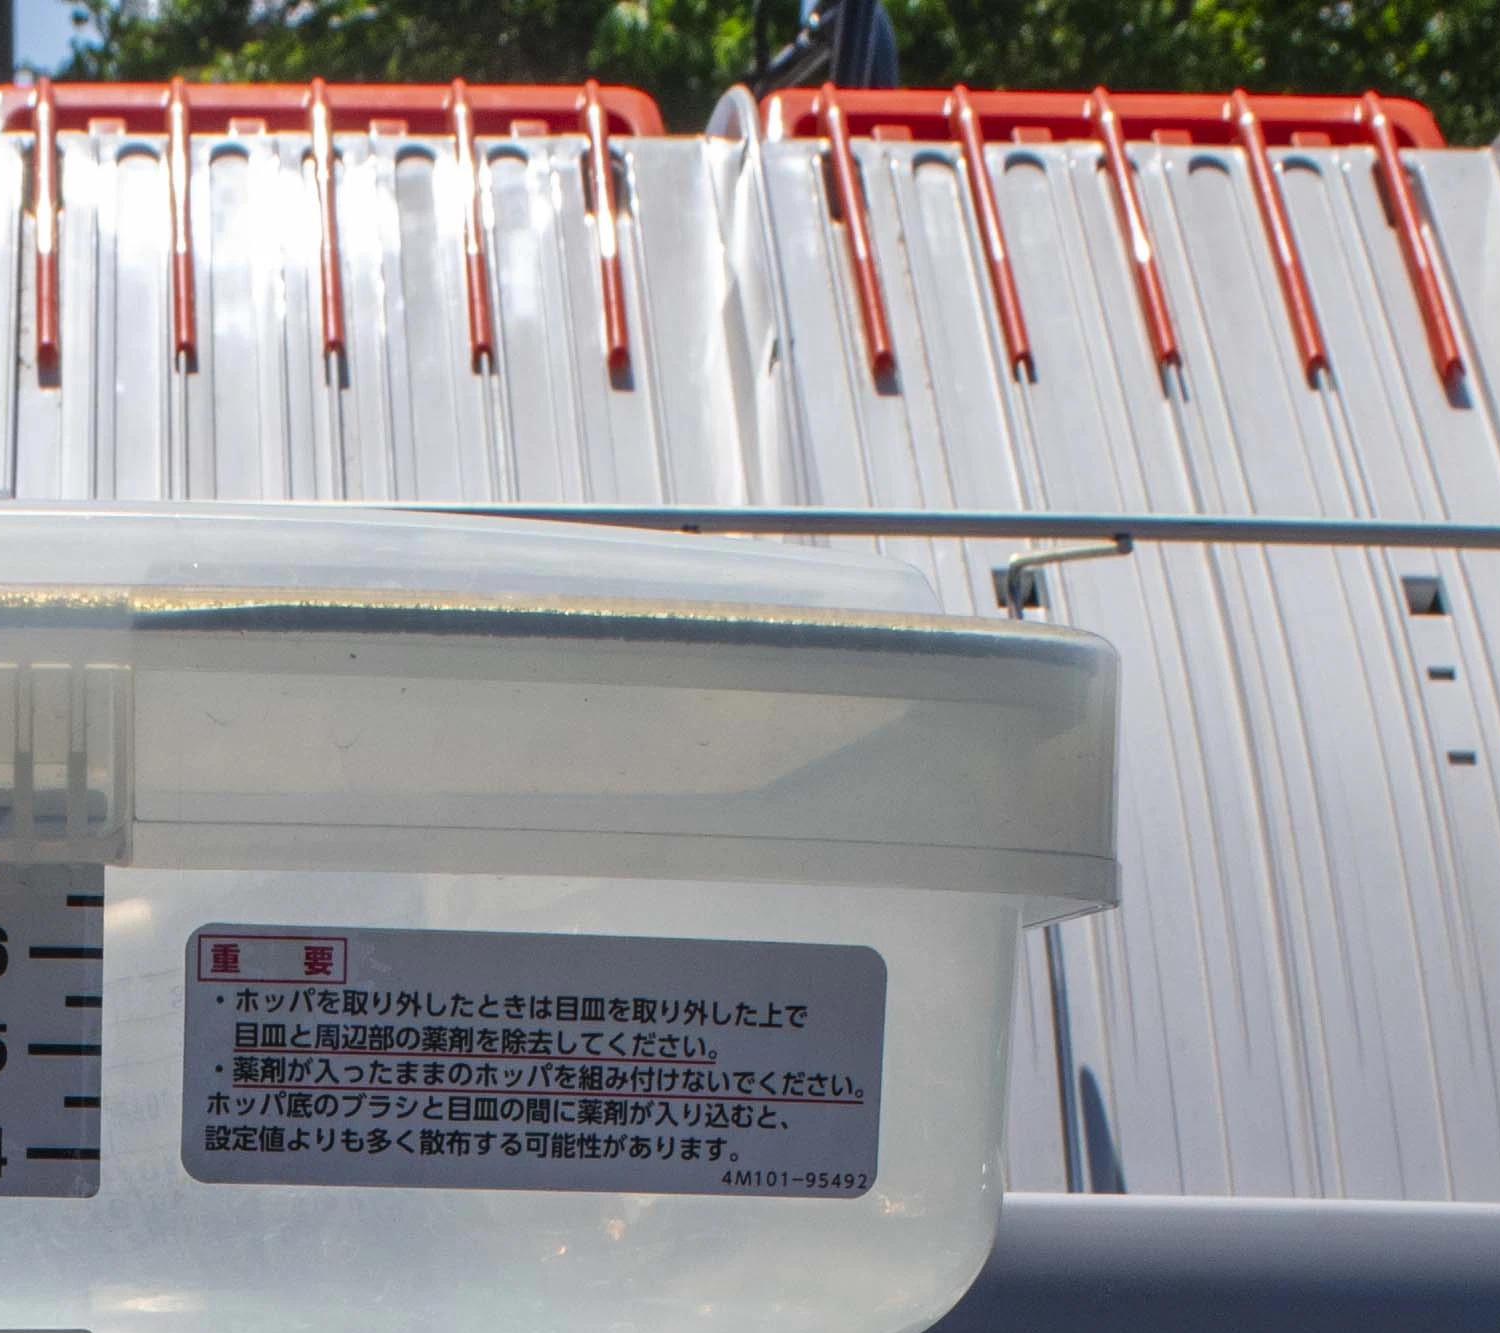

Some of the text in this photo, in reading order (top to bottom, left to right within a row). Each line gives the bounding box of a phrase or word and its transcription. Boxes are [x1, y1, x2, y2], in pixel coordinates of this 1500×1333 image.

[234, 1022, 718, 1061] 目皿と周辺部の薬剤を除去してください。
[207, 1093, 789, 1130] ホッパ底のブラシと目皿の間に薬剤が入り込むと、
[205, 1125, 740, 1163] 設定値よりも多く散布する可能性があります。
[721, 1170, 868, 1190] 4M101-95492
